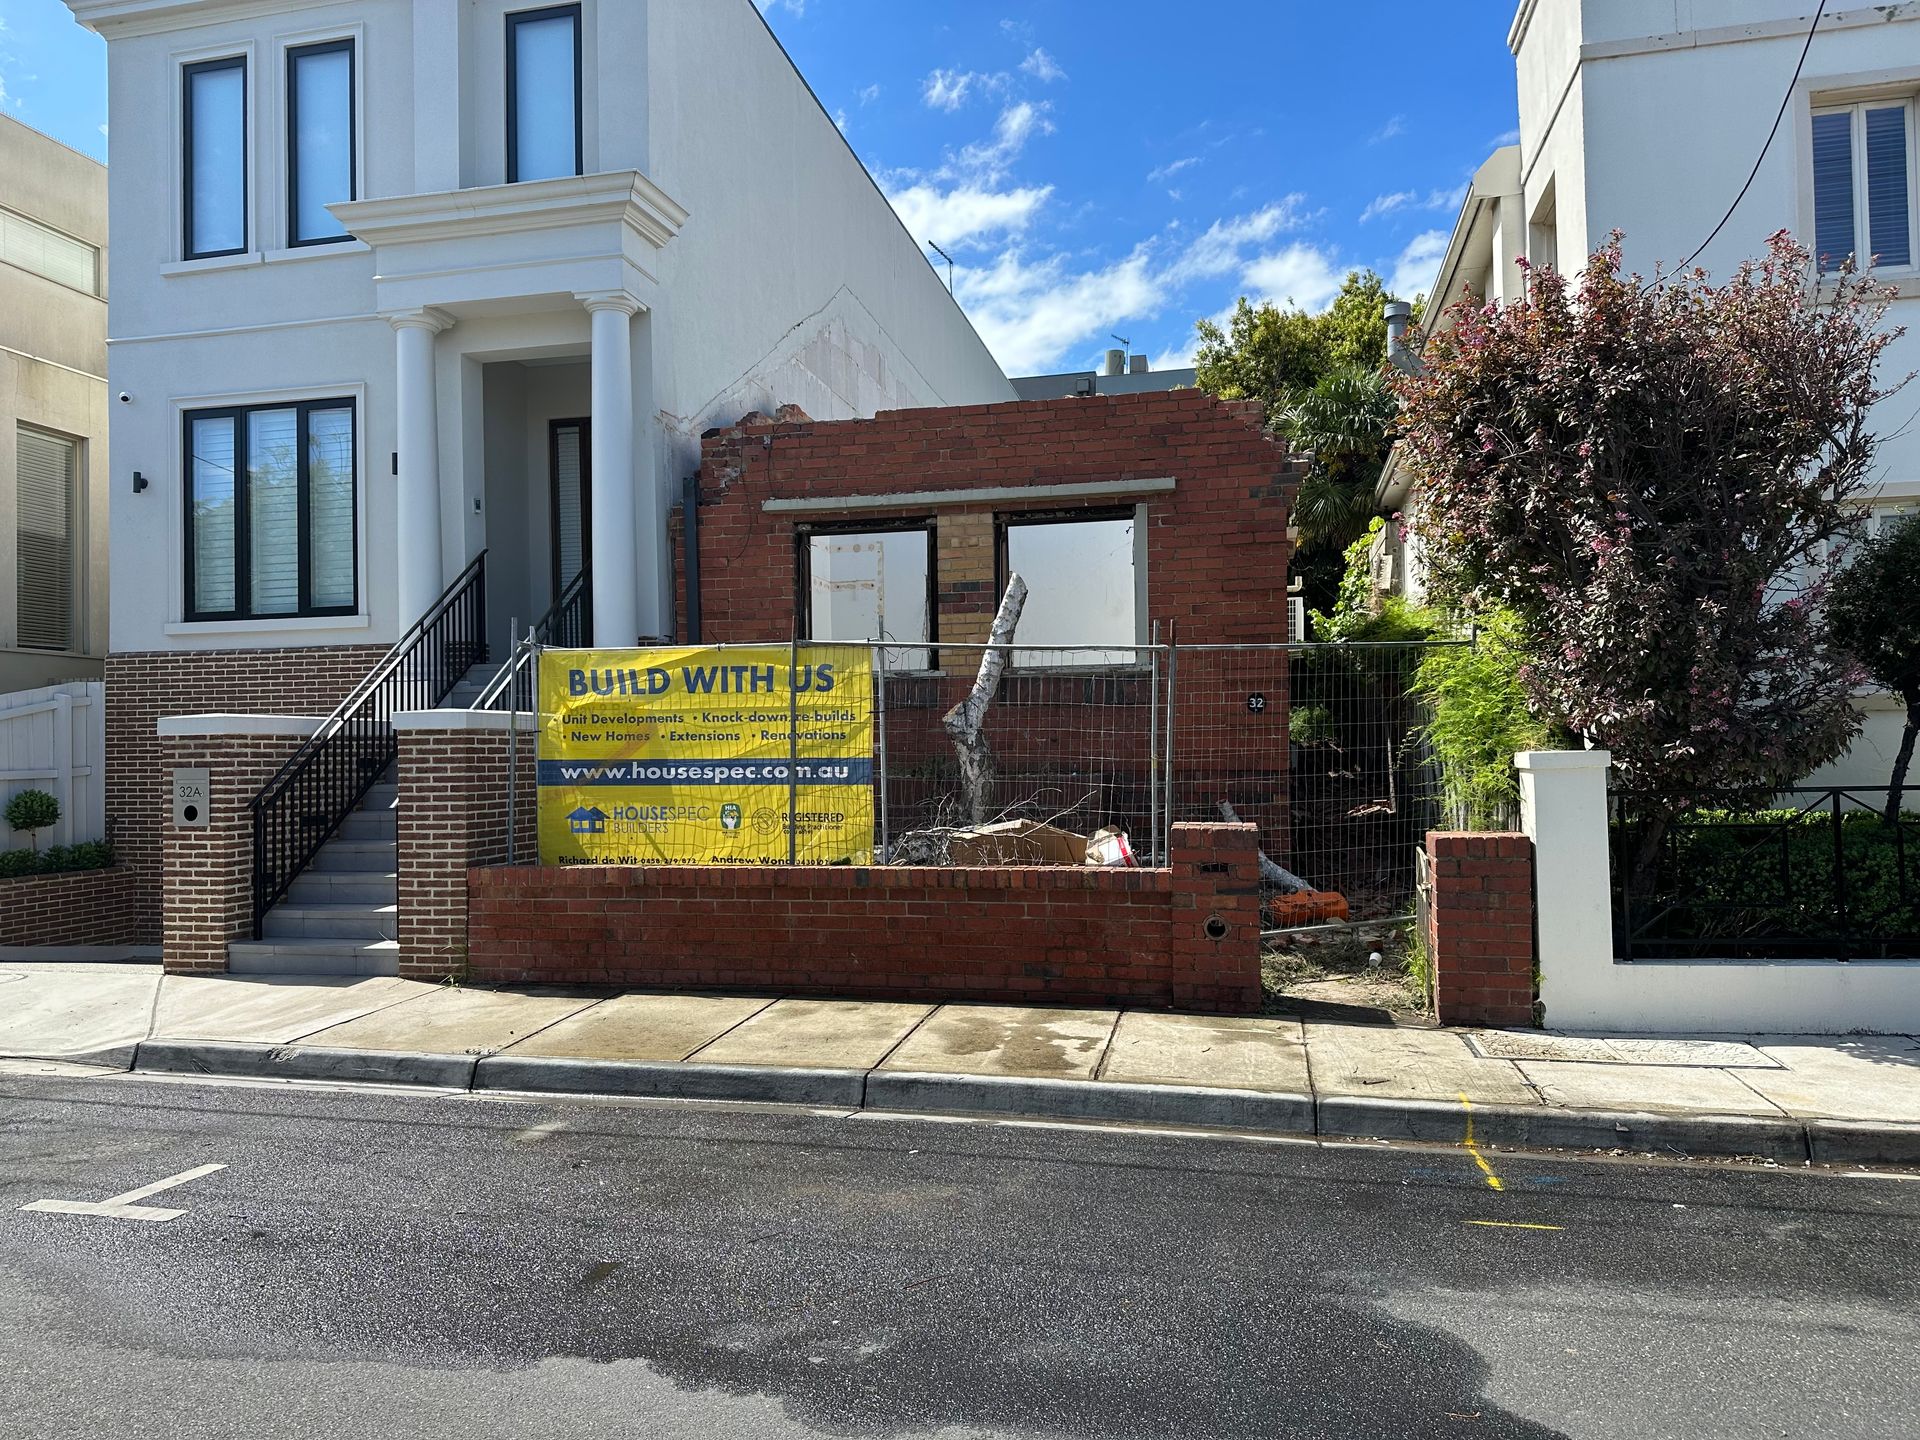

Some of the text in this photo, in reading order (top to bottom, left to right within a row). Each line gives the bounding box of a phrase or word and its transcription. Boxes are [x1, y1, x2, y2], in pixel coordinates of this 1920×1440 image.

[568, 663, 835, 697] BUILD WITH US
[1249, 697, 1264, 708] 32
[562, 713, 588, 725] Unit
[591, 712, 684, 727] Developments
[571, 731, 602, 742] New
[605, 731, 650, 742] Homes
[669, 729, 741, 742] Extensions
[560, 761, 849, 784] www.housespec.com.au
[179, 786, 202, 798] 32A
[613, 805, 710, 821] HOUSESPEC
[781, 812, 845, 823] RGISTERED
[613, 821, 669, 834] BUILDERS
[558, 855, 598, 865] Richard
[601, 855, 616, 865] de
[618, 856, 638, 865] Wit
[711, 855, 755, 865] Andrew
